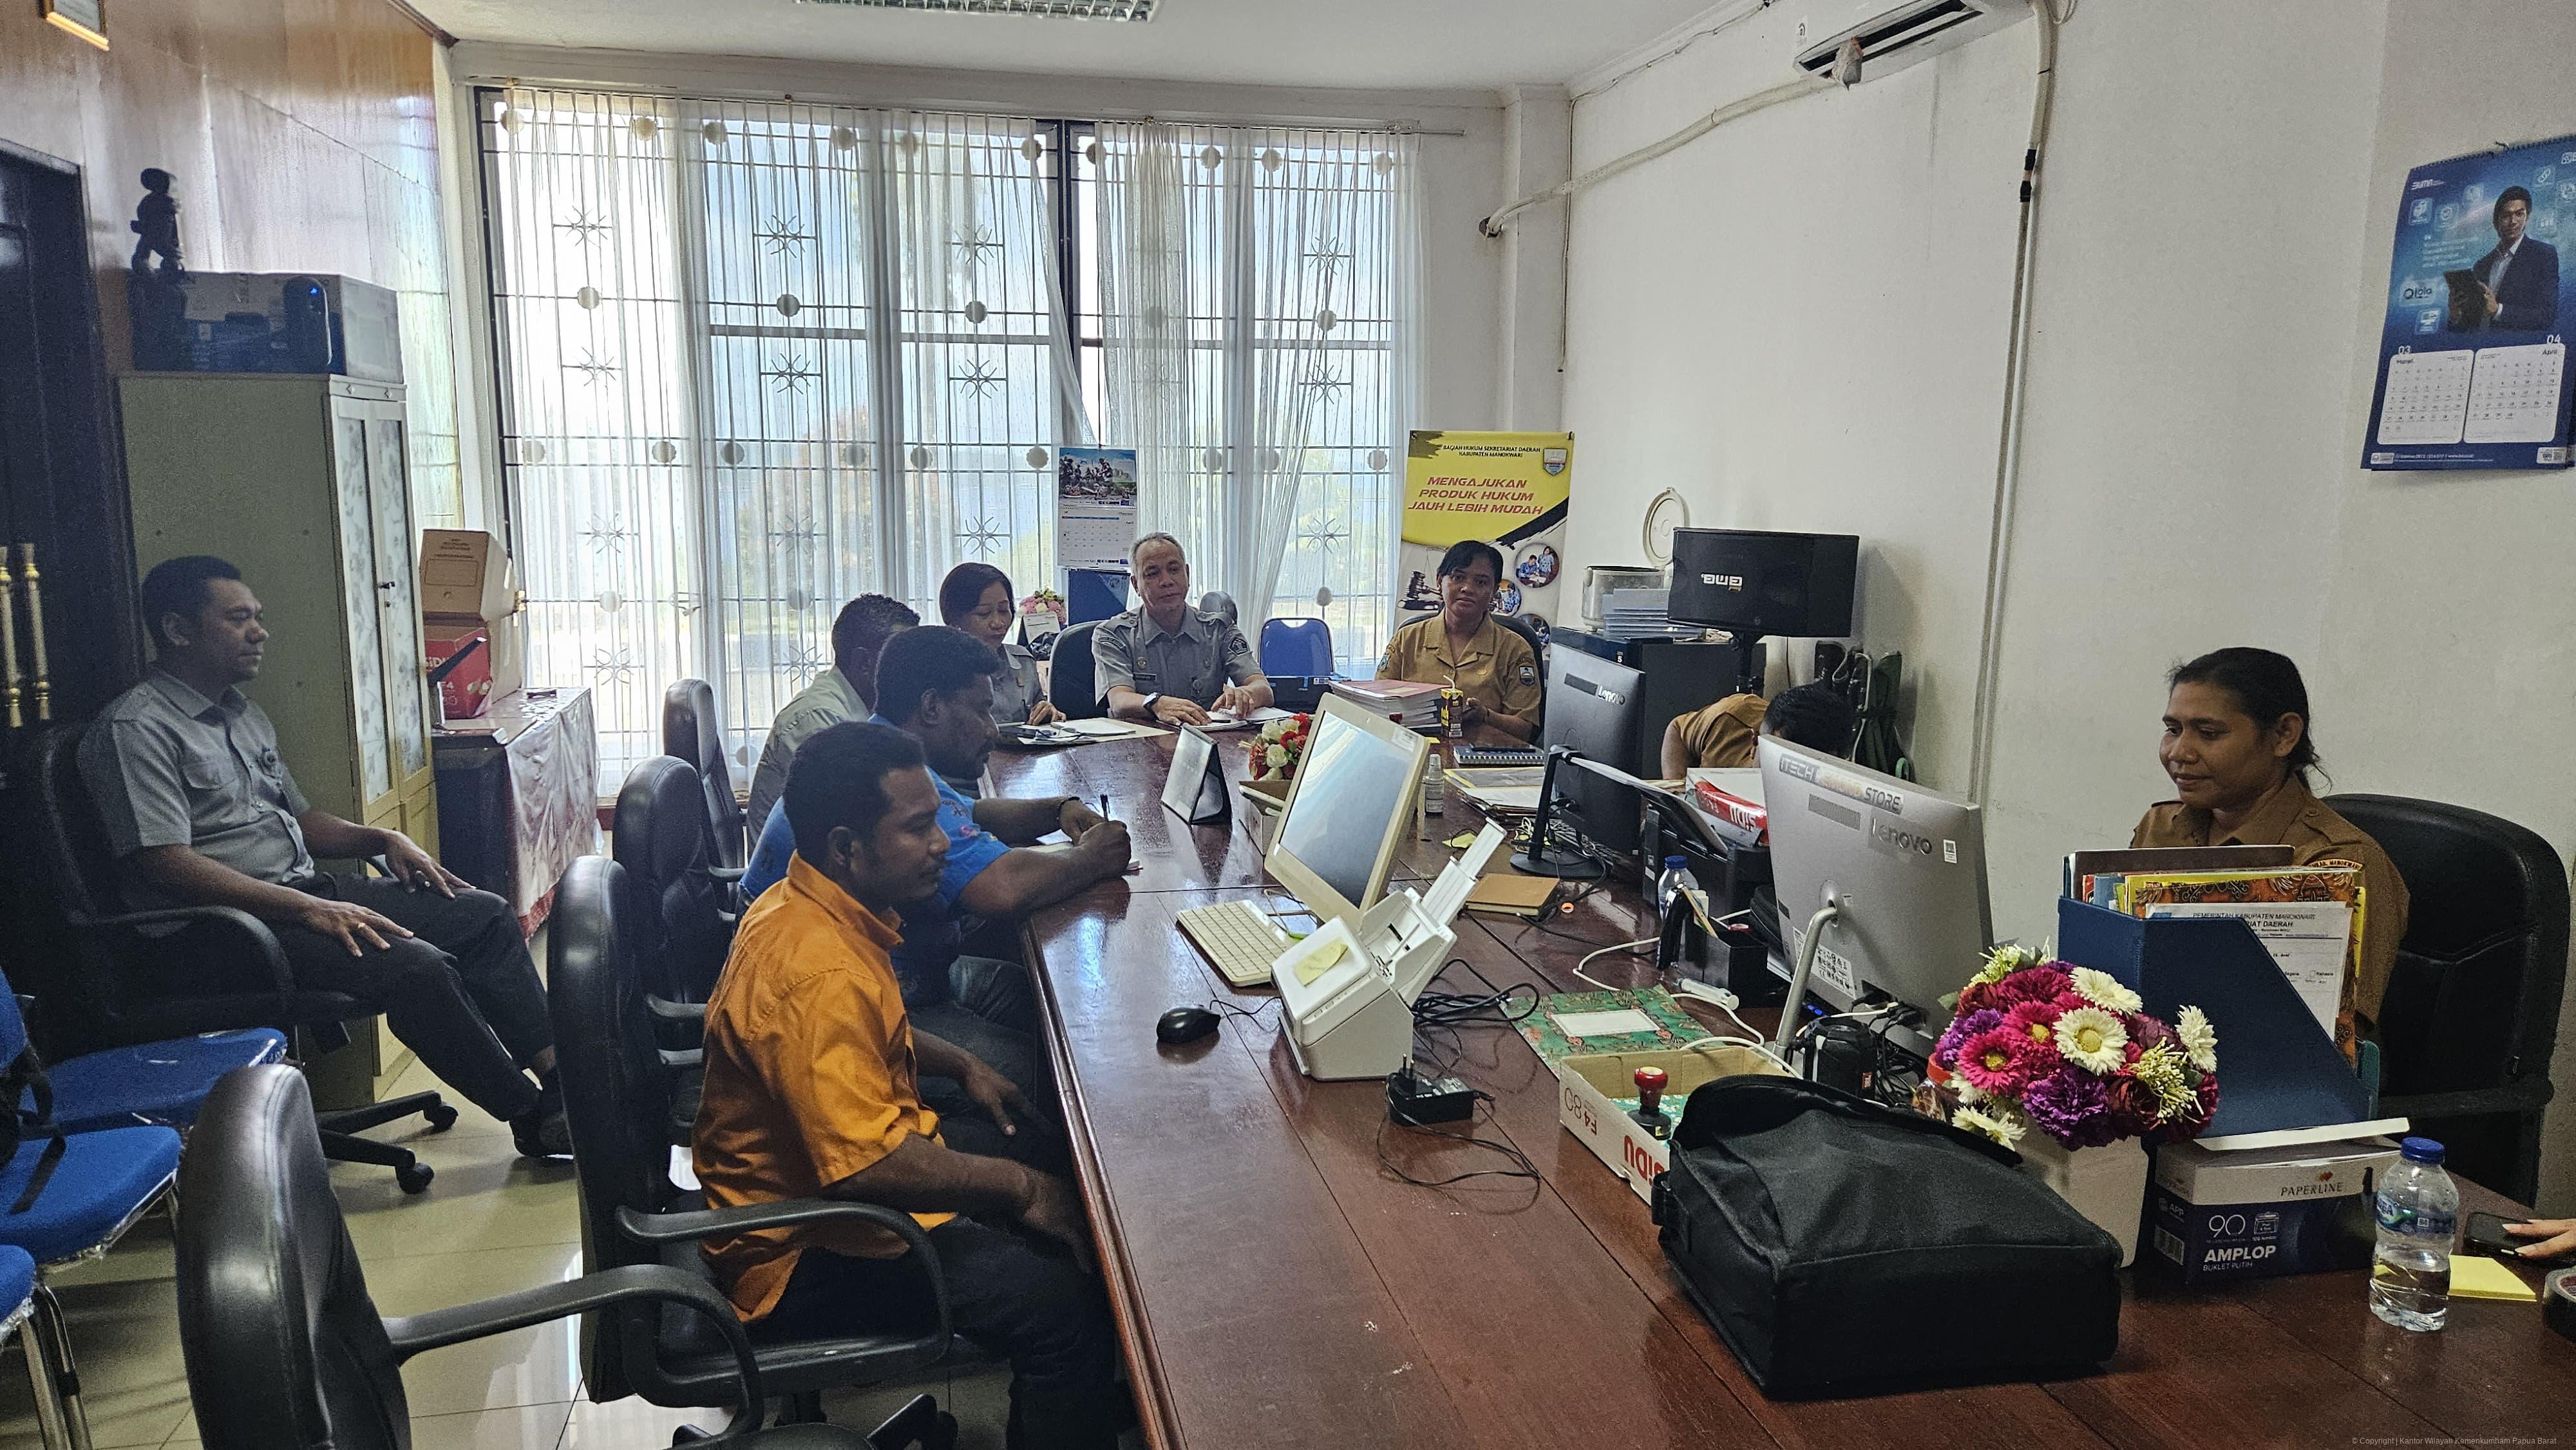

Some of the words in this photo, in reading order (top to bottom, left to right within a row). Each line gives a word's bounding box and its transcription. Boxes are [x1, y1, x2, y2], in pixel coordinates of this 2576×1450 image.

[2546, 334, 2561, 344] 04
[2398, 345, 2411, 354] 03
[1427, 476, 1527, 488] MENGAJUKAN
[1419, 489, 1477, 499] PRODUK
[1481, 492, 1534, 501] HUKUM
[1408, 502, 1445, 511] JAUH
[1447, 503, 1488, 513] LEBIH
[1490, 504, 1543, 514] MUDAH
[1598, 685, 1625, 706] Lenovo
[1864, 787, 1902, 813] STORE
[1564, 1087, 1582, 1119] 80
[1584, 1111, 1597, 1135] F4
[2280, 1182, 2343, 1196] PAPERLINE
[2209, 1214, 2246, 1238] 90
[2204, 1245, 2277, 1263] AMPLOP
[2203, 1263, 2230, 1272] BUKLET
